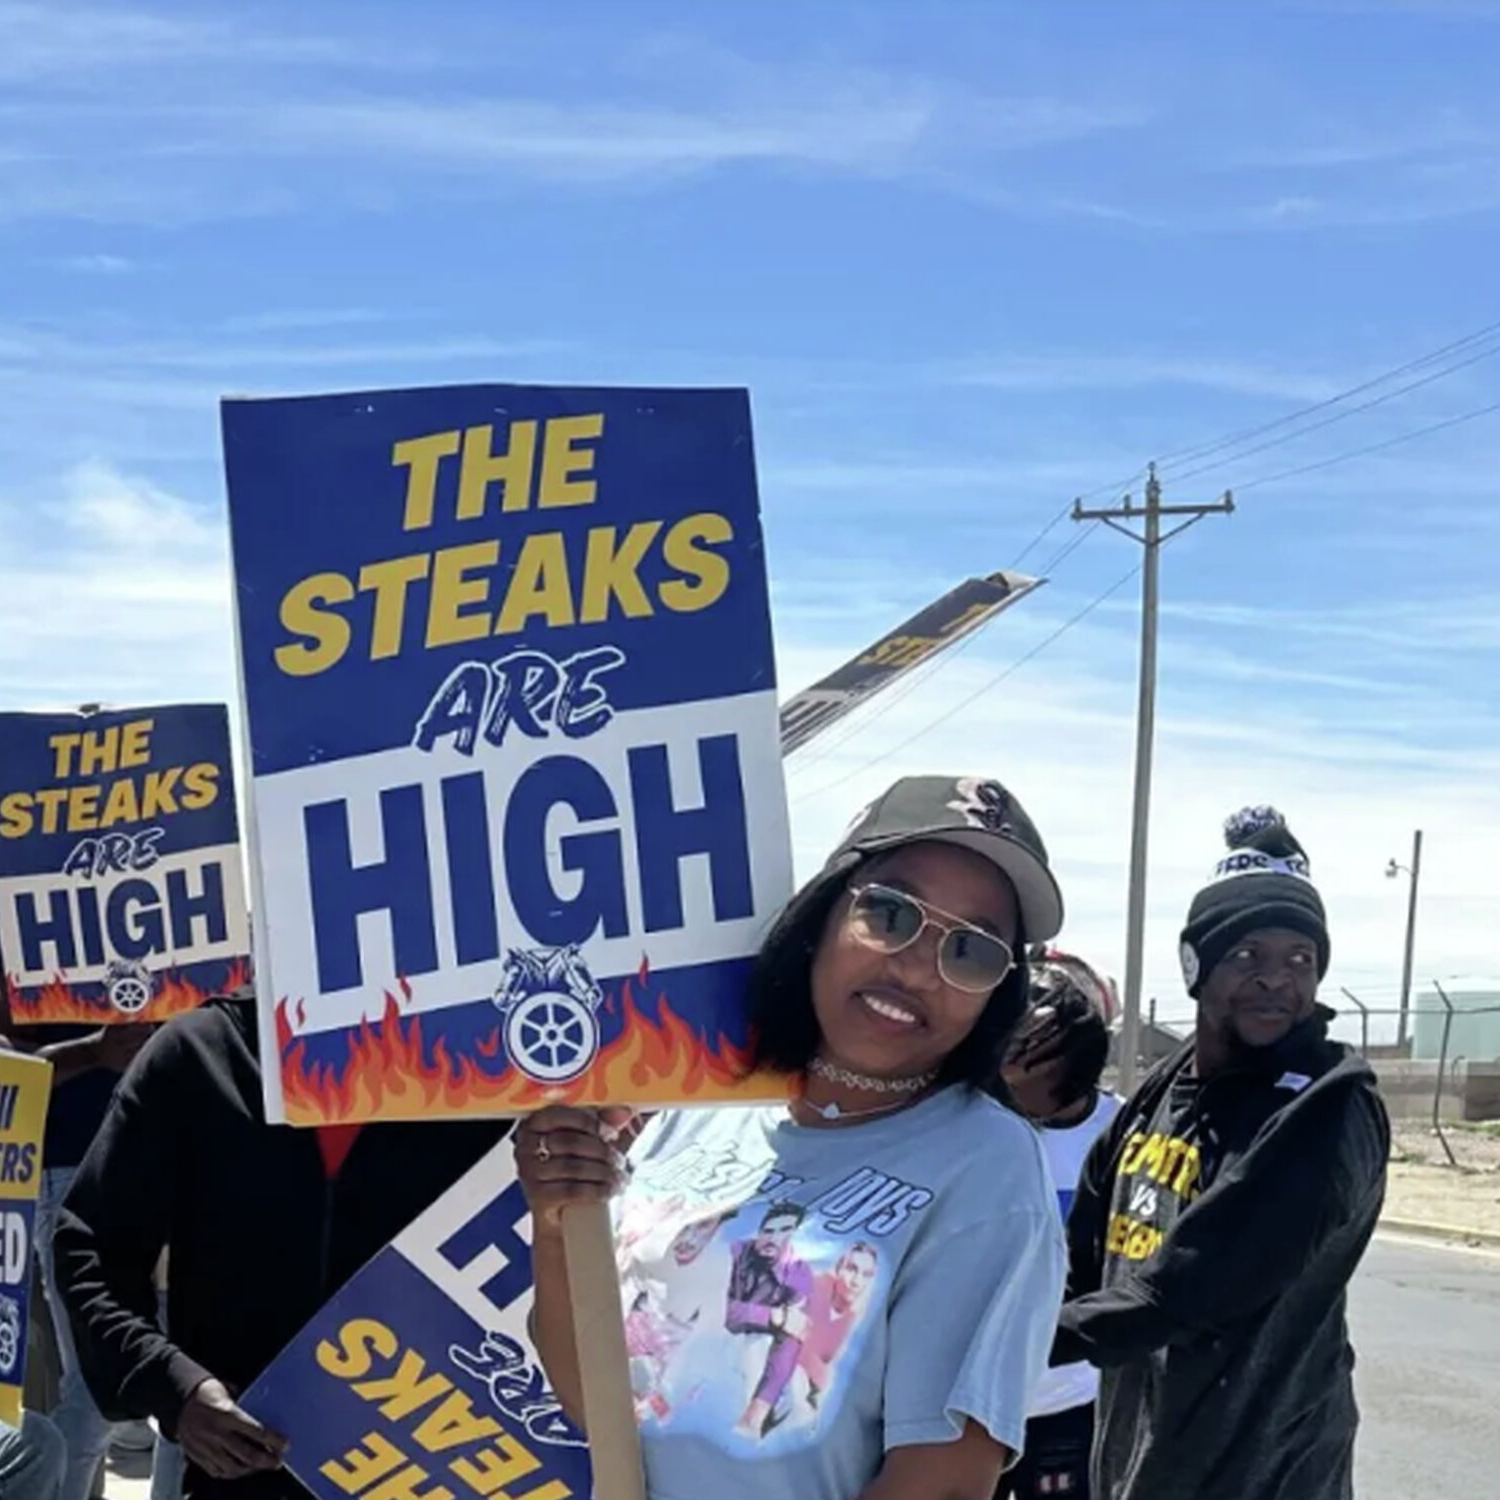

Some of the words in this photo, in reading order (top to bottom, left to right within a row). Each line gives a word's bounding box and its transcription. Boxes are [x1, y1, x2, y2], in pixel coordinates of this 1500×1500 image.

[392, 412, 604, 532] THE
[273, 512, 735, 677] STEAKS
[49, 718, 154, 779] THE
[415, 645, 626, 756] ARE
[62, 827, 165, 880] ARE
[303, 732, 755, 996] HIGH
[14, 861, 229, 972] HIGH
